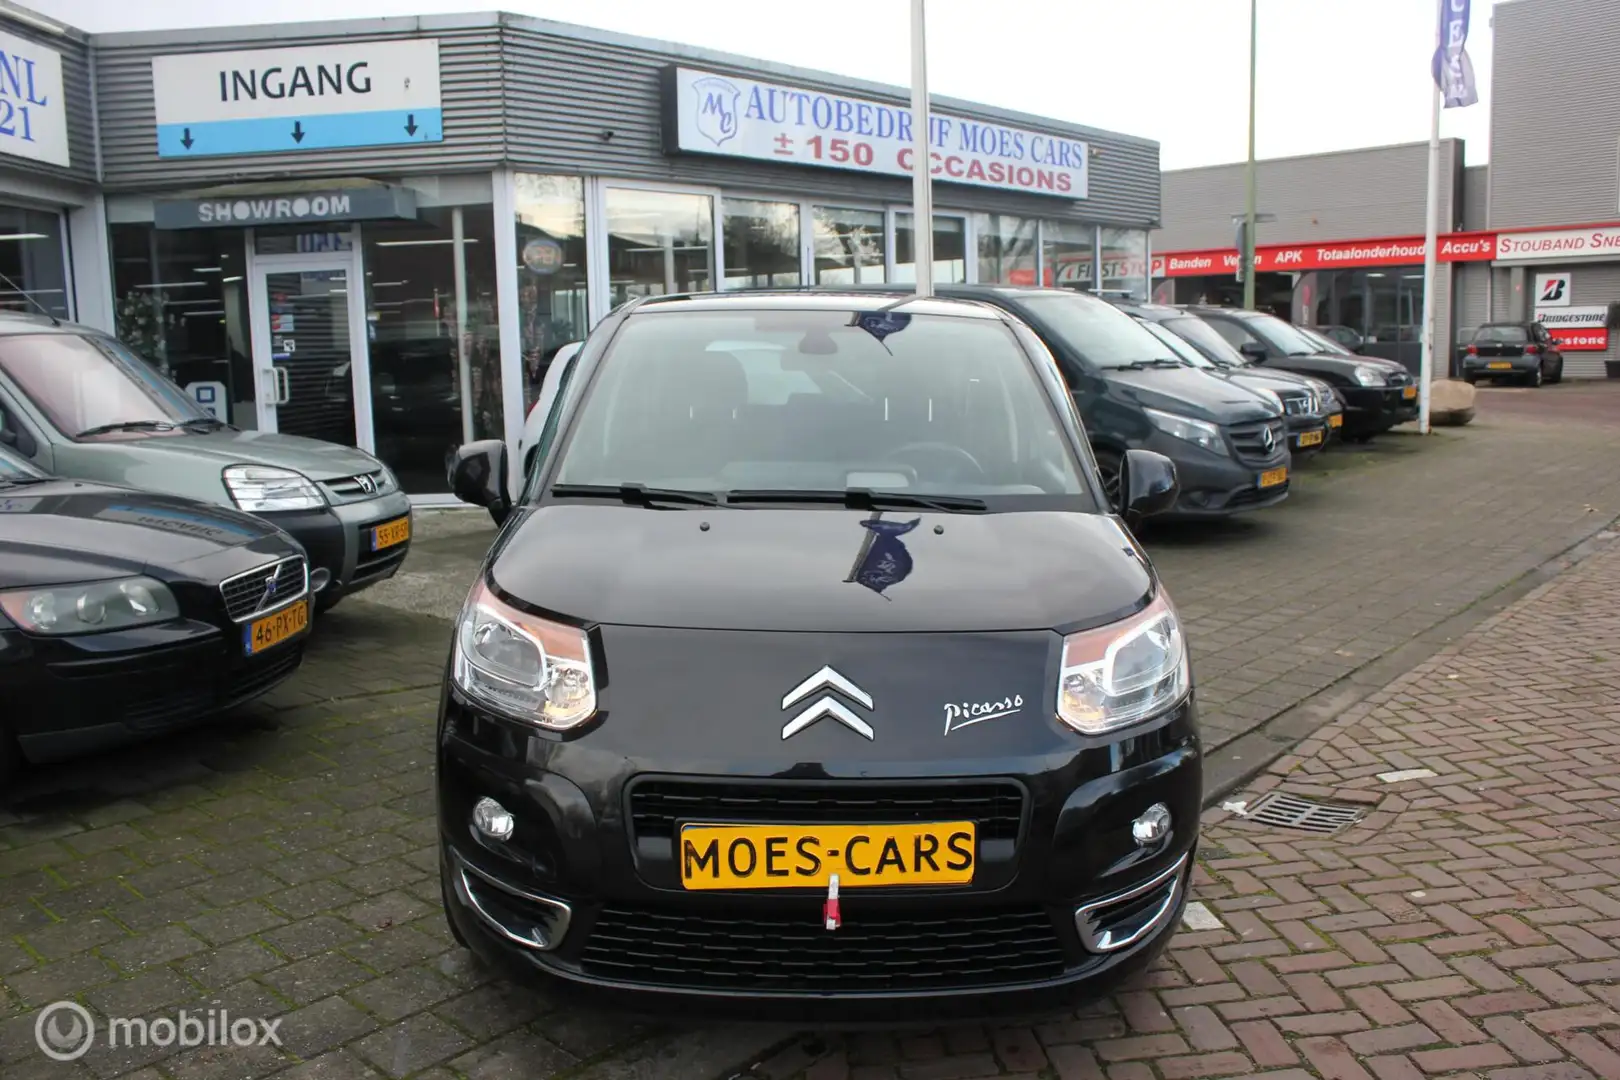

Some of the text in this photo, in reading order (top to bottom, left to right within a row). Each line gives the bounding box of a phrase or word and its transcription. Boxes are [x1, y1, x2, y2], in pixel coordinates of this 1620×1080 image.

[220, 62, 372, 101] INGANG
[744, 84, 952, 147] AUTOBEDRJF
[960, 123, 1025, 161] MOES
[1030, 136, 1083, 169] CARS
[806, 135, 874, 167] 150
[198, 195, 350, 222] SHOWROOM
[1169, 257, 1212, 270] Banden
[1274, 250, 1303, 264] APK
[1316, 243, 1426, 261] Totaalonderhoud
[1441, 239, 1491, 254] Accu's
[1500, 237, 1585, 253] STOUBAND
[1537, 313, 1605, 323] BRIDGESTONE
[255, 604, 304, 645] 46-PX-TG
[944, 694, 1023, 735] Picasso
[683, 832, 973, 879] MOES-CARS
